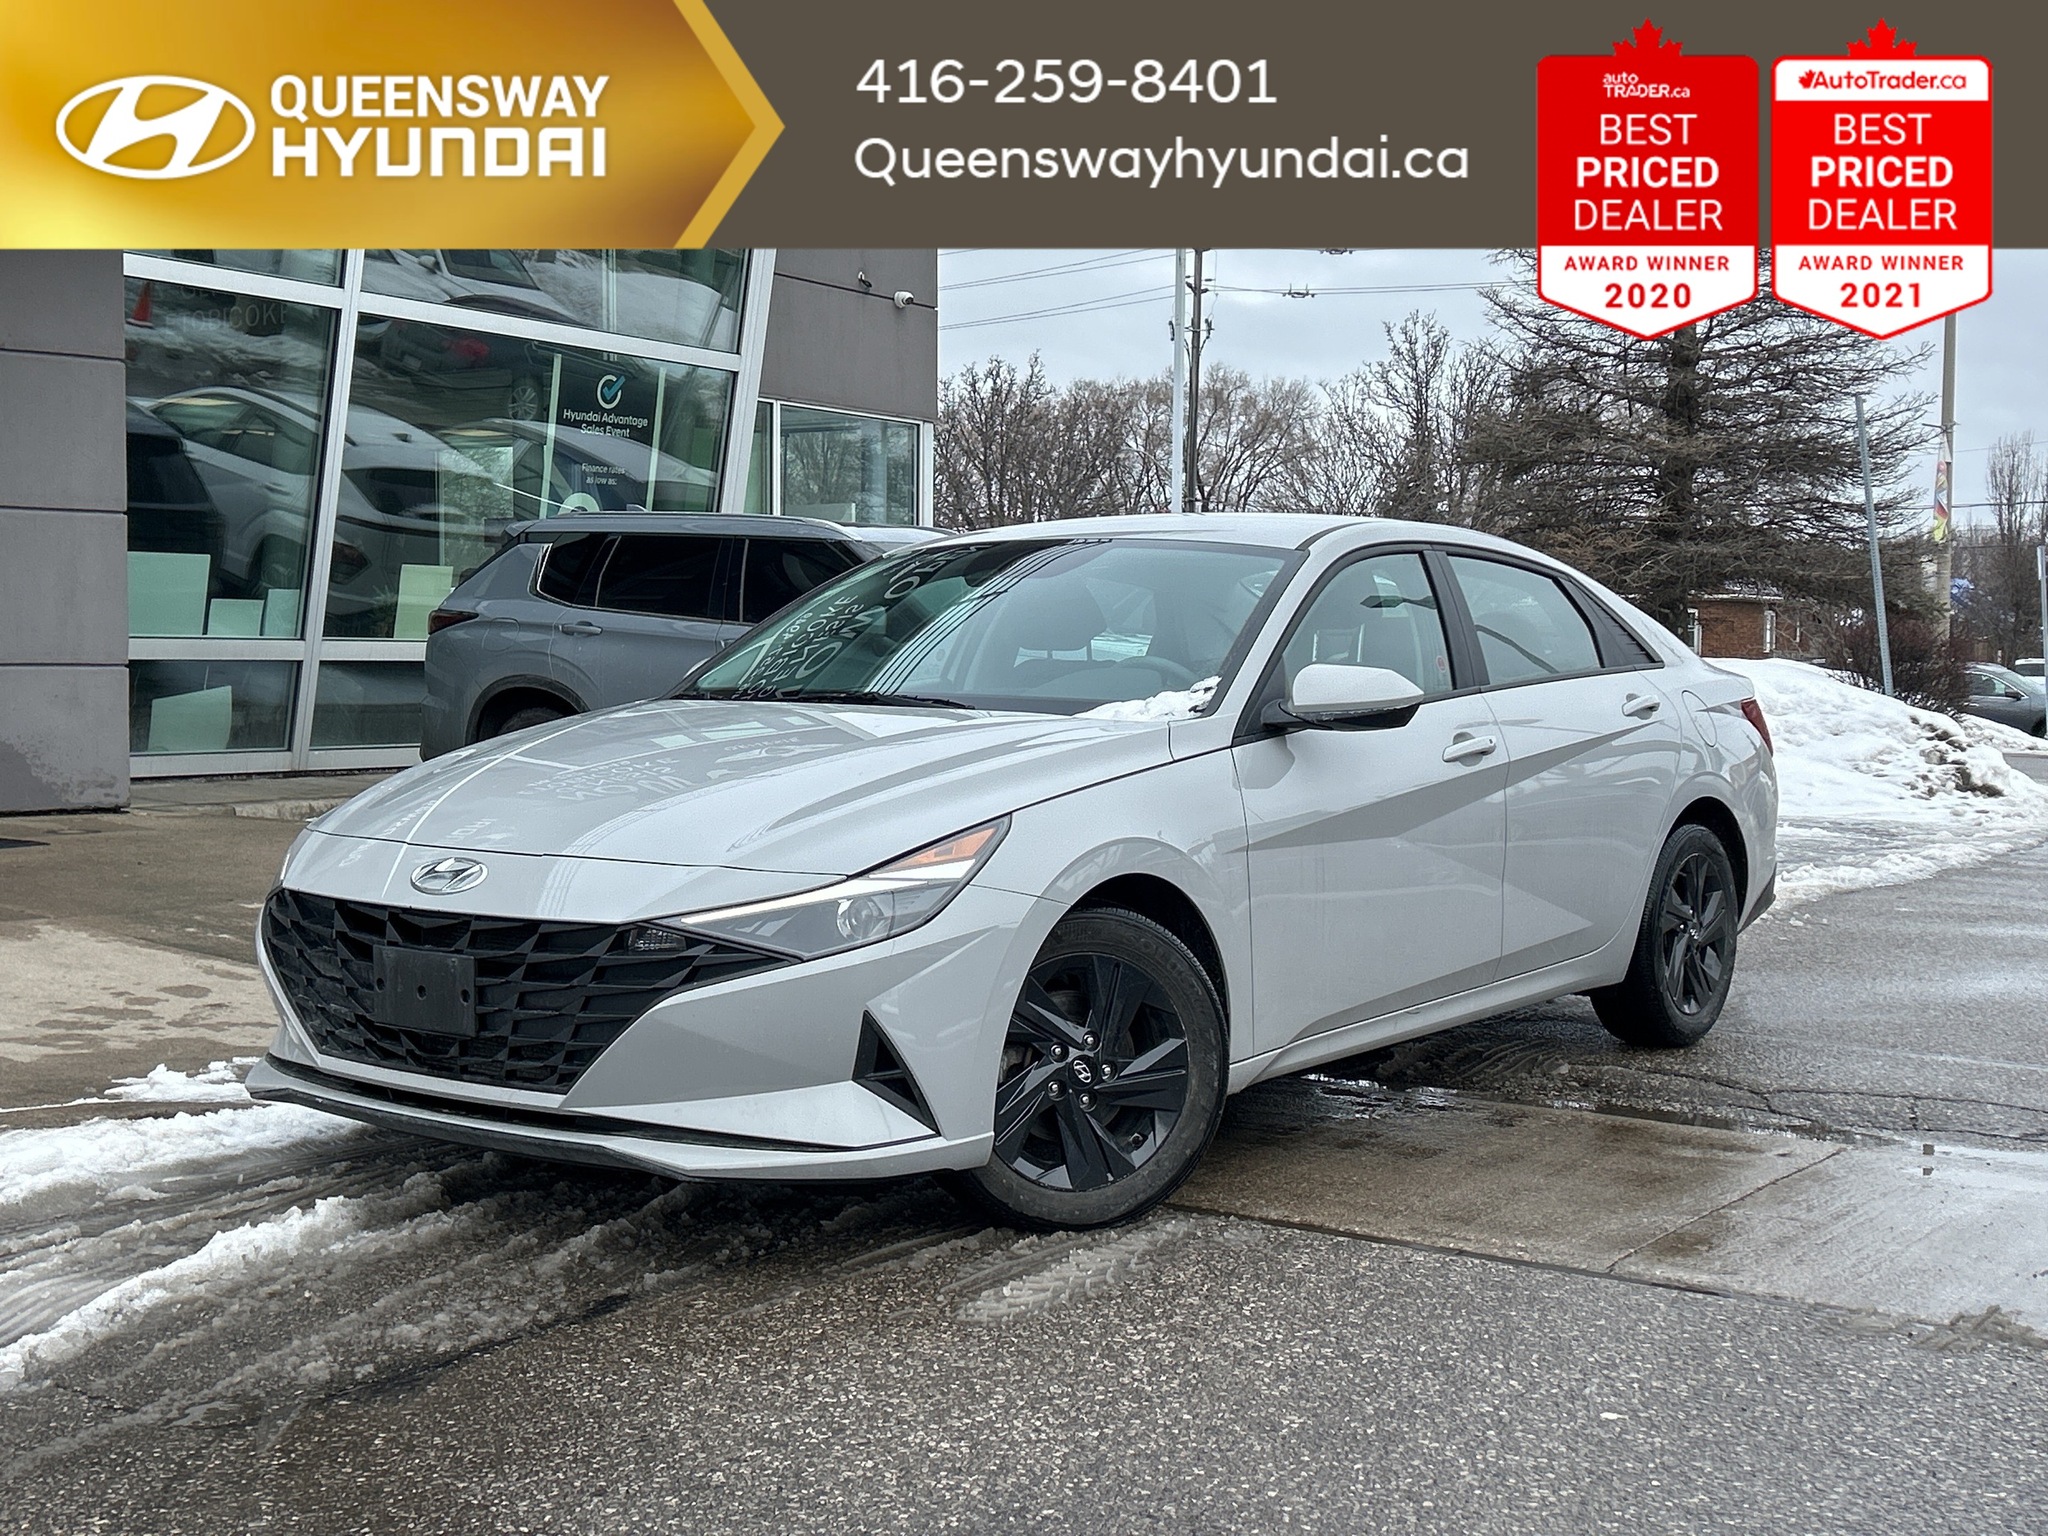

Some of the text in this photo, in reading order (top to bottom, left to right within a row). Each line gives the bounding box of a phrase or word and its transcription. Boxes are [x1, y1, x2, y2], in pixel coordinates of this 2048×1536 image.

[563, 408, 649, 429] Hyundai Advantage
[580, 423, 630, 438] Sales Event
[581, 462, 608, 475] Finance
